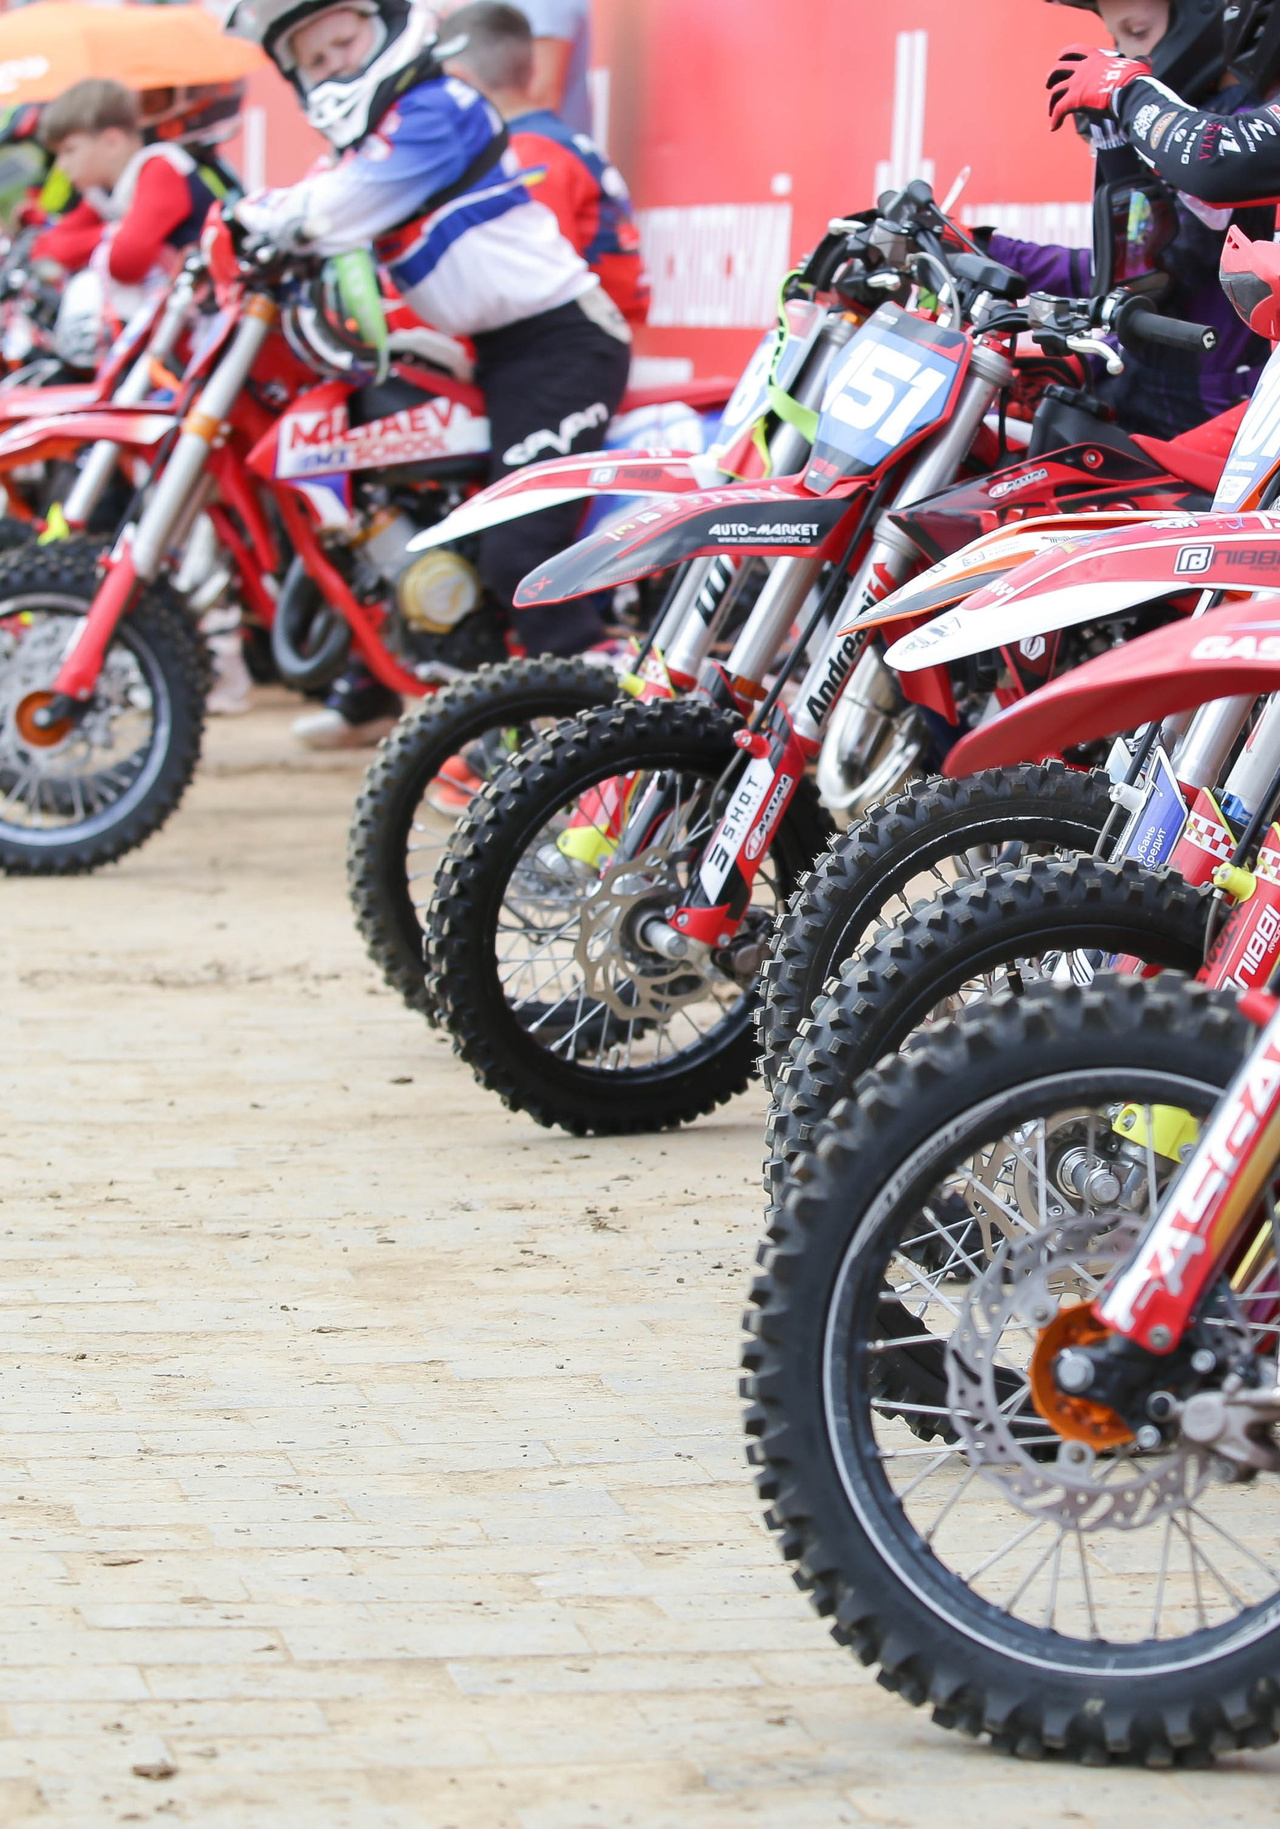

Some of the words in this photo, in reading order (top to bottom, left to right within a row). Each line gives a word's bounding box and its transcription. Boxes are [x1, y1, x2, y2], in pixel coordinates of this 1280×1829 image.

[821, 339, 947, 446] 151
[708, 523, 819, 537] AUTO-MARKET
[722, 775, 759, 840] SHOT
